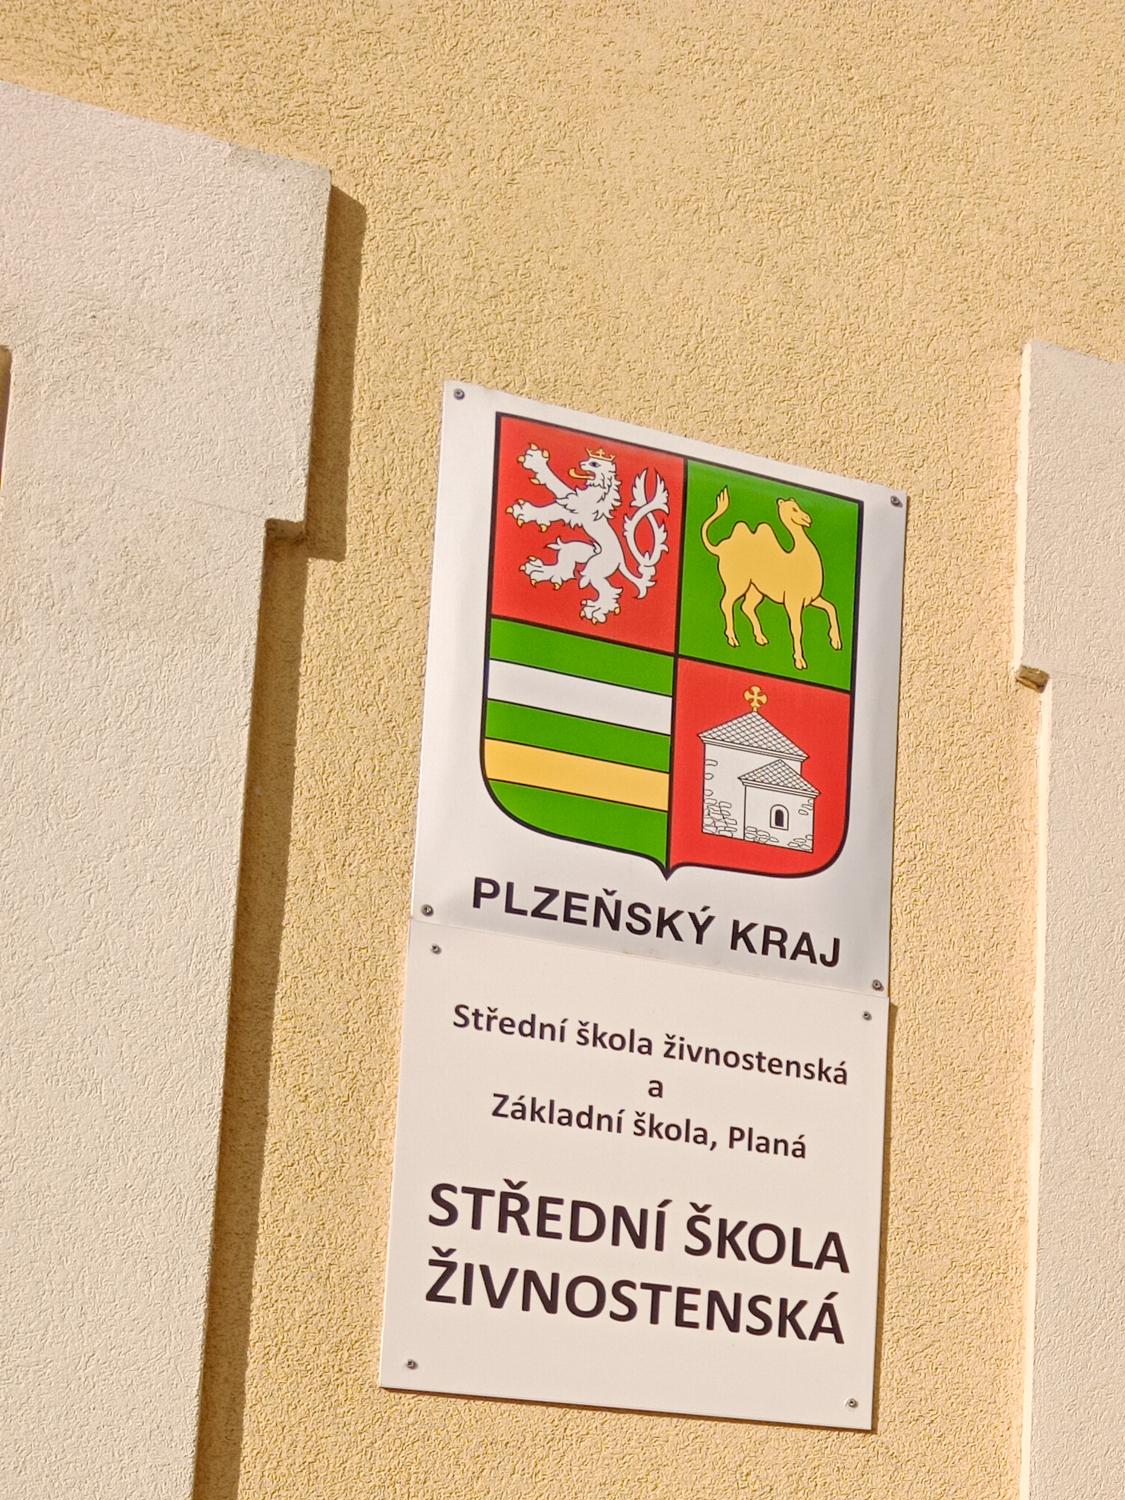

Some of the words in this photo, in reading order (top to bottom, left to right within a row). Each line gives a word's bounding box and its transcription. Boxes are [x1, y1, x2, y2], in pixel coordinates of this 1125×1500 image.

[472, 876, 716, 946] PLZEŇSKÝ
[730, 919, 841, 968] KRAJ
[452, 1004, 569, 1044] Střední
[576, 1019, 653, 1056] škola
[663, 1033, 849, 1086] živnostenská
[491, 1092, 625, 1134] Základní
[633, 1110, 718, 1152] škola,
[728, 1126, 807, 1159] Planá
[647, 1079, 664, 1099] a
[428, 1178, 673, 1252] STŘEDNÍ
[684, 1201, 850, 1274] ŠKOLA
[425, 1245, 845, 1345] ŽIVNOSTENSKÁ
